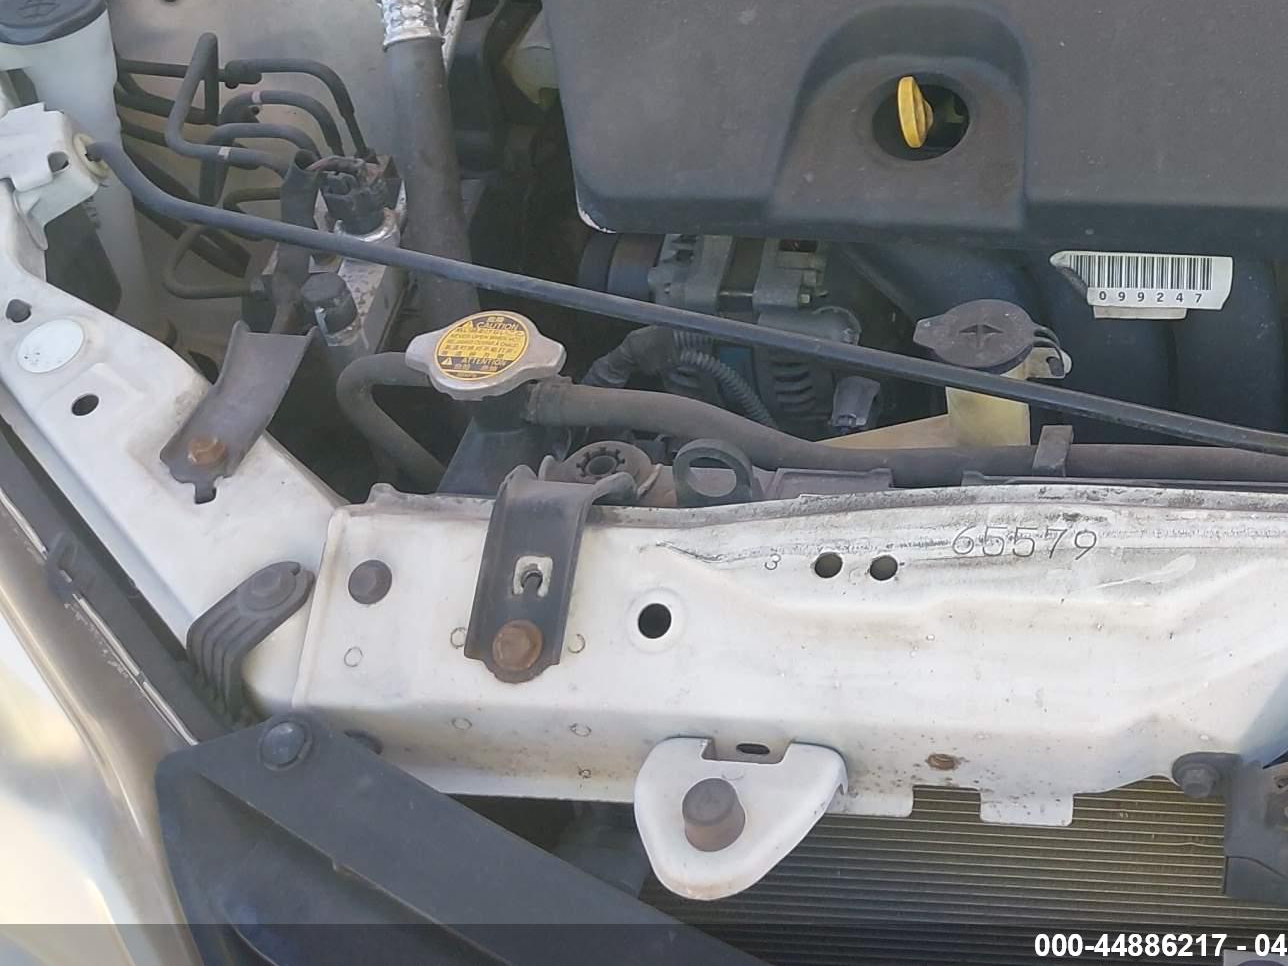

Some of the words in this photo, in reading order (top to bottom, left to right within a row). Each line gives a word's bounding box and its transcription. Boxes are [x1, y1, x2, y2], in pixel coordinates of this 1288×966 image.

[1099, 291, 1202, 303] 099247
[476, 321, 520, 331] CAUTION
[952, 525, 1098, 561] 65579
